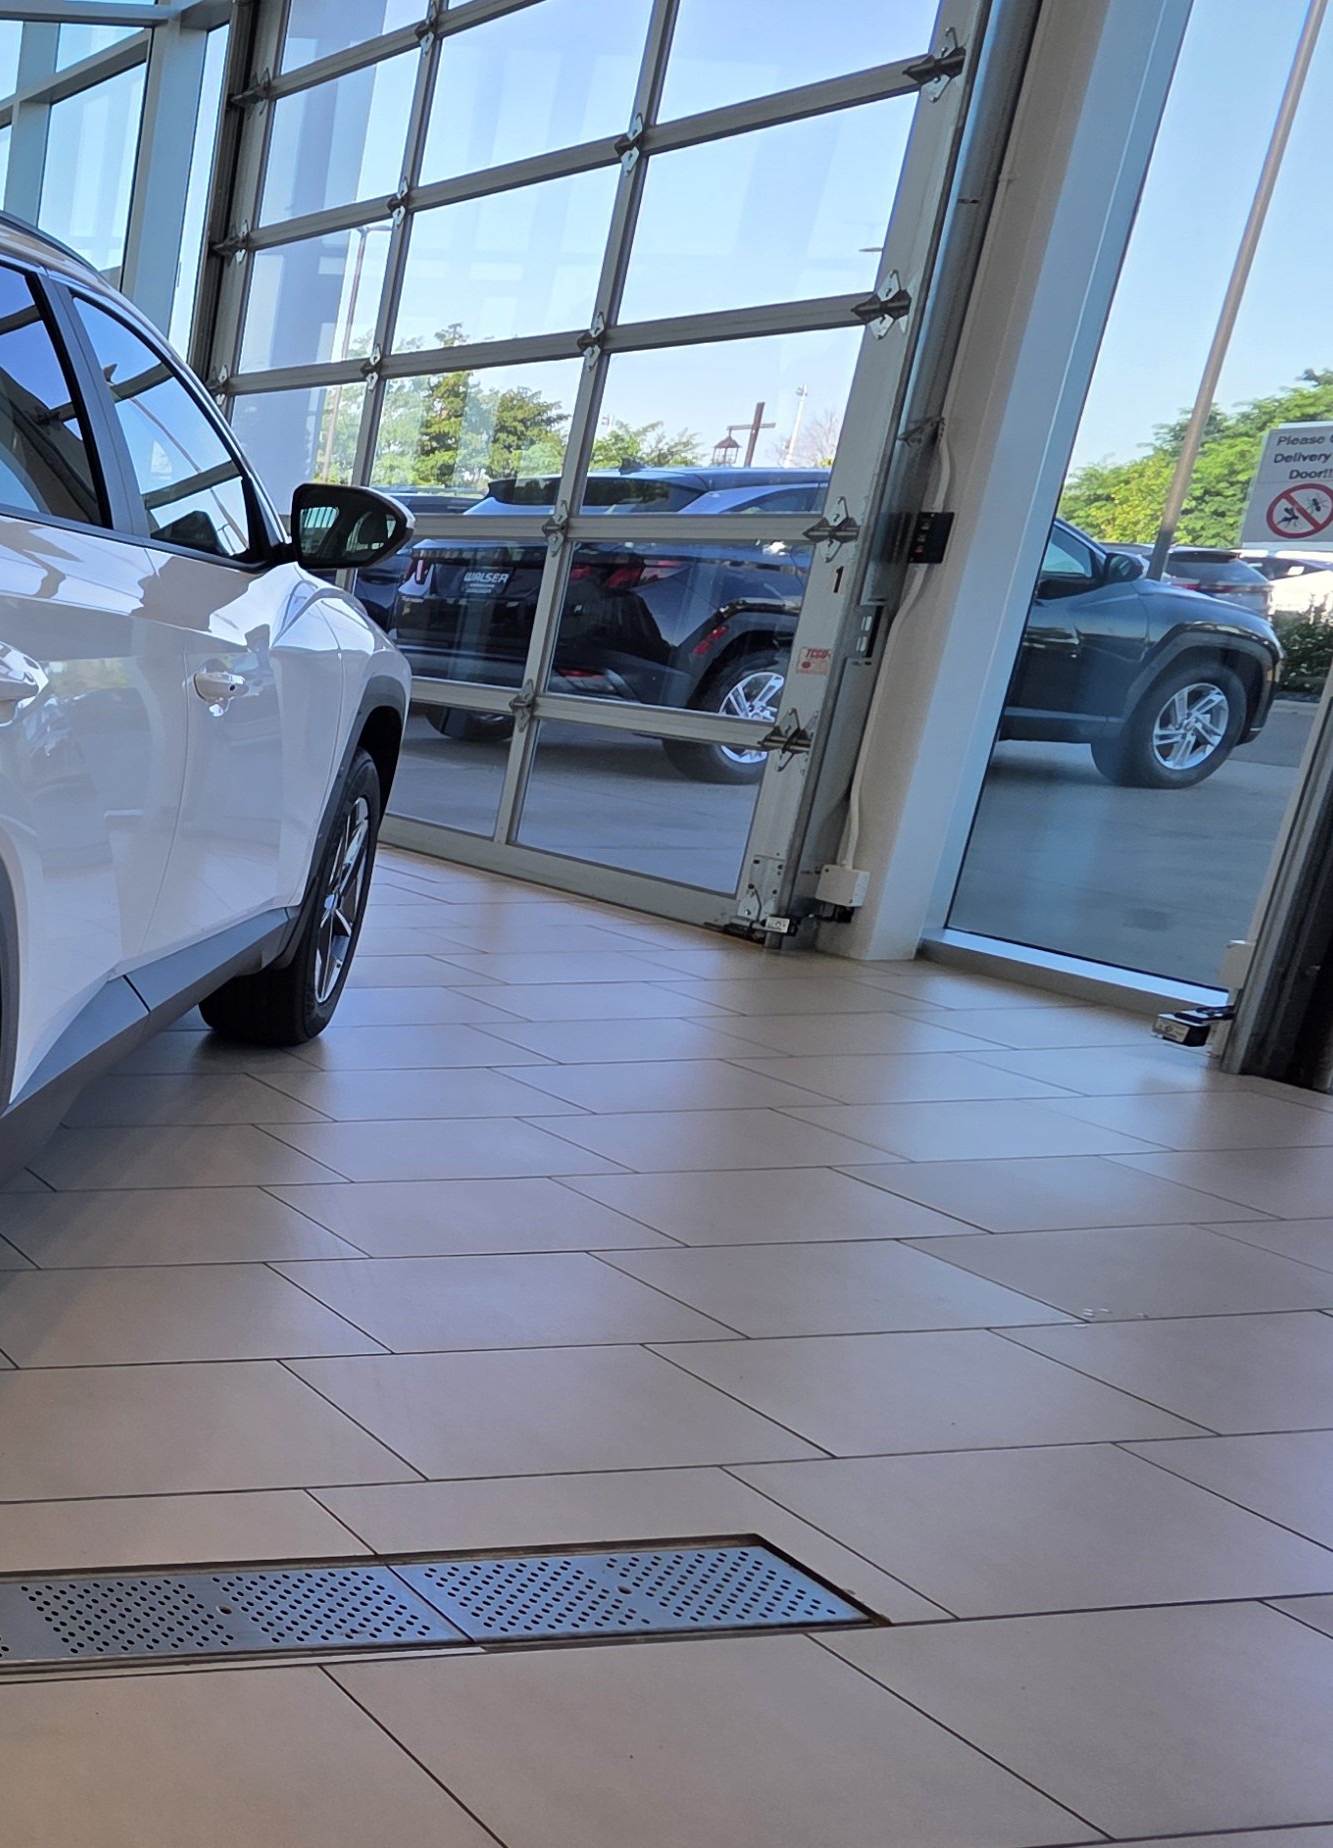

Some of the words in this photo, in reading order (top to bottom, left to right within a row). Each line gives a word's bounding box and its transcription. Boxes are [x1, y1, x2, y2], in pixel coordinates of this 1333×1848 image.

[1276, 435, 1326, 447] Please
[1274, 452, 1333, 464] Delivery
[463, 571, 510, 584] WALSER
[833, 565, 845, 594] 1
